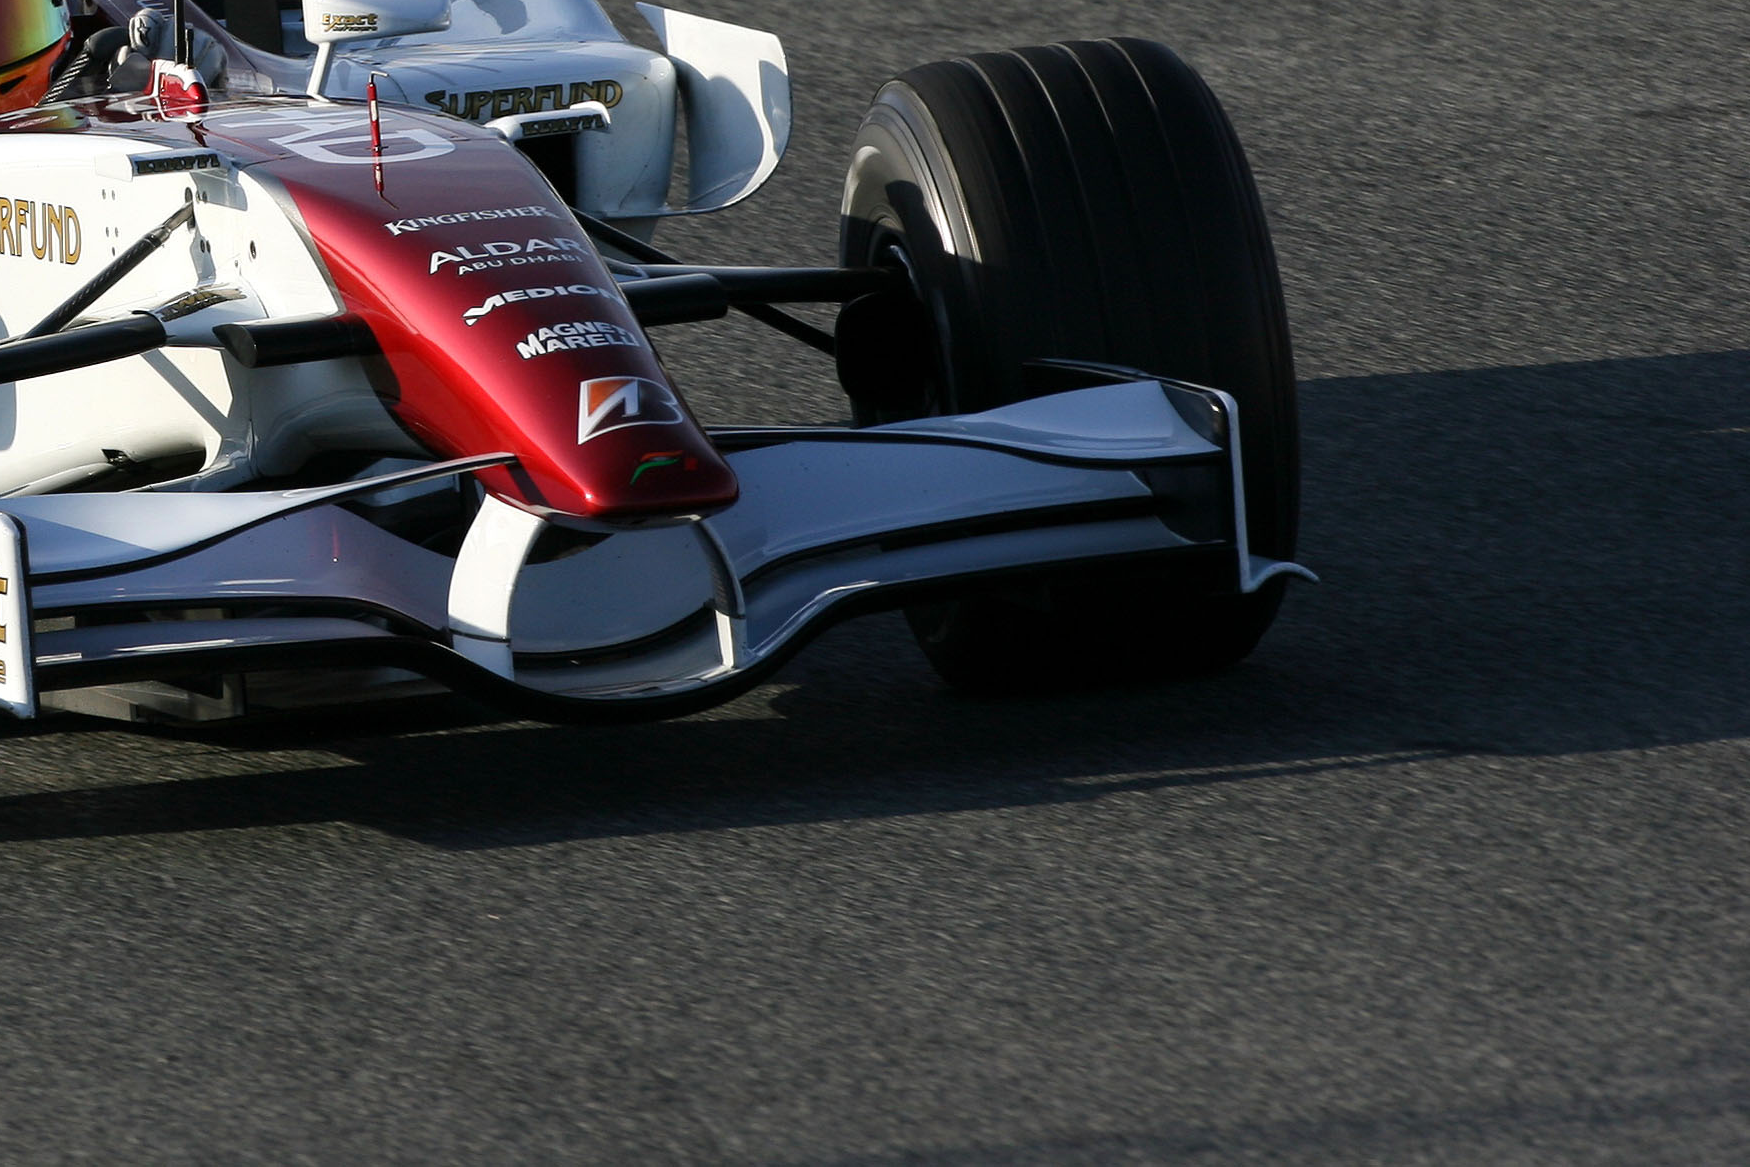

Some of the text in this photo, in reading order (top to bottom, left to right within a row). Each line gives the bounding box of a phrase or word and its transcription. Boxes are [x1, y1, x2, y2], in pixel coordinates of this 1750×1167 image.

[322, 12, 379, 32] Exact
[425, 79, 624, 121] SUPERFUND
[383, 205, 562, 236] KINGFISHER
[428, 237, 588, 275] ALDAR
[457, 253, 584, 276] ABU DHABI
[462, 284, 627, 327] MEDION
